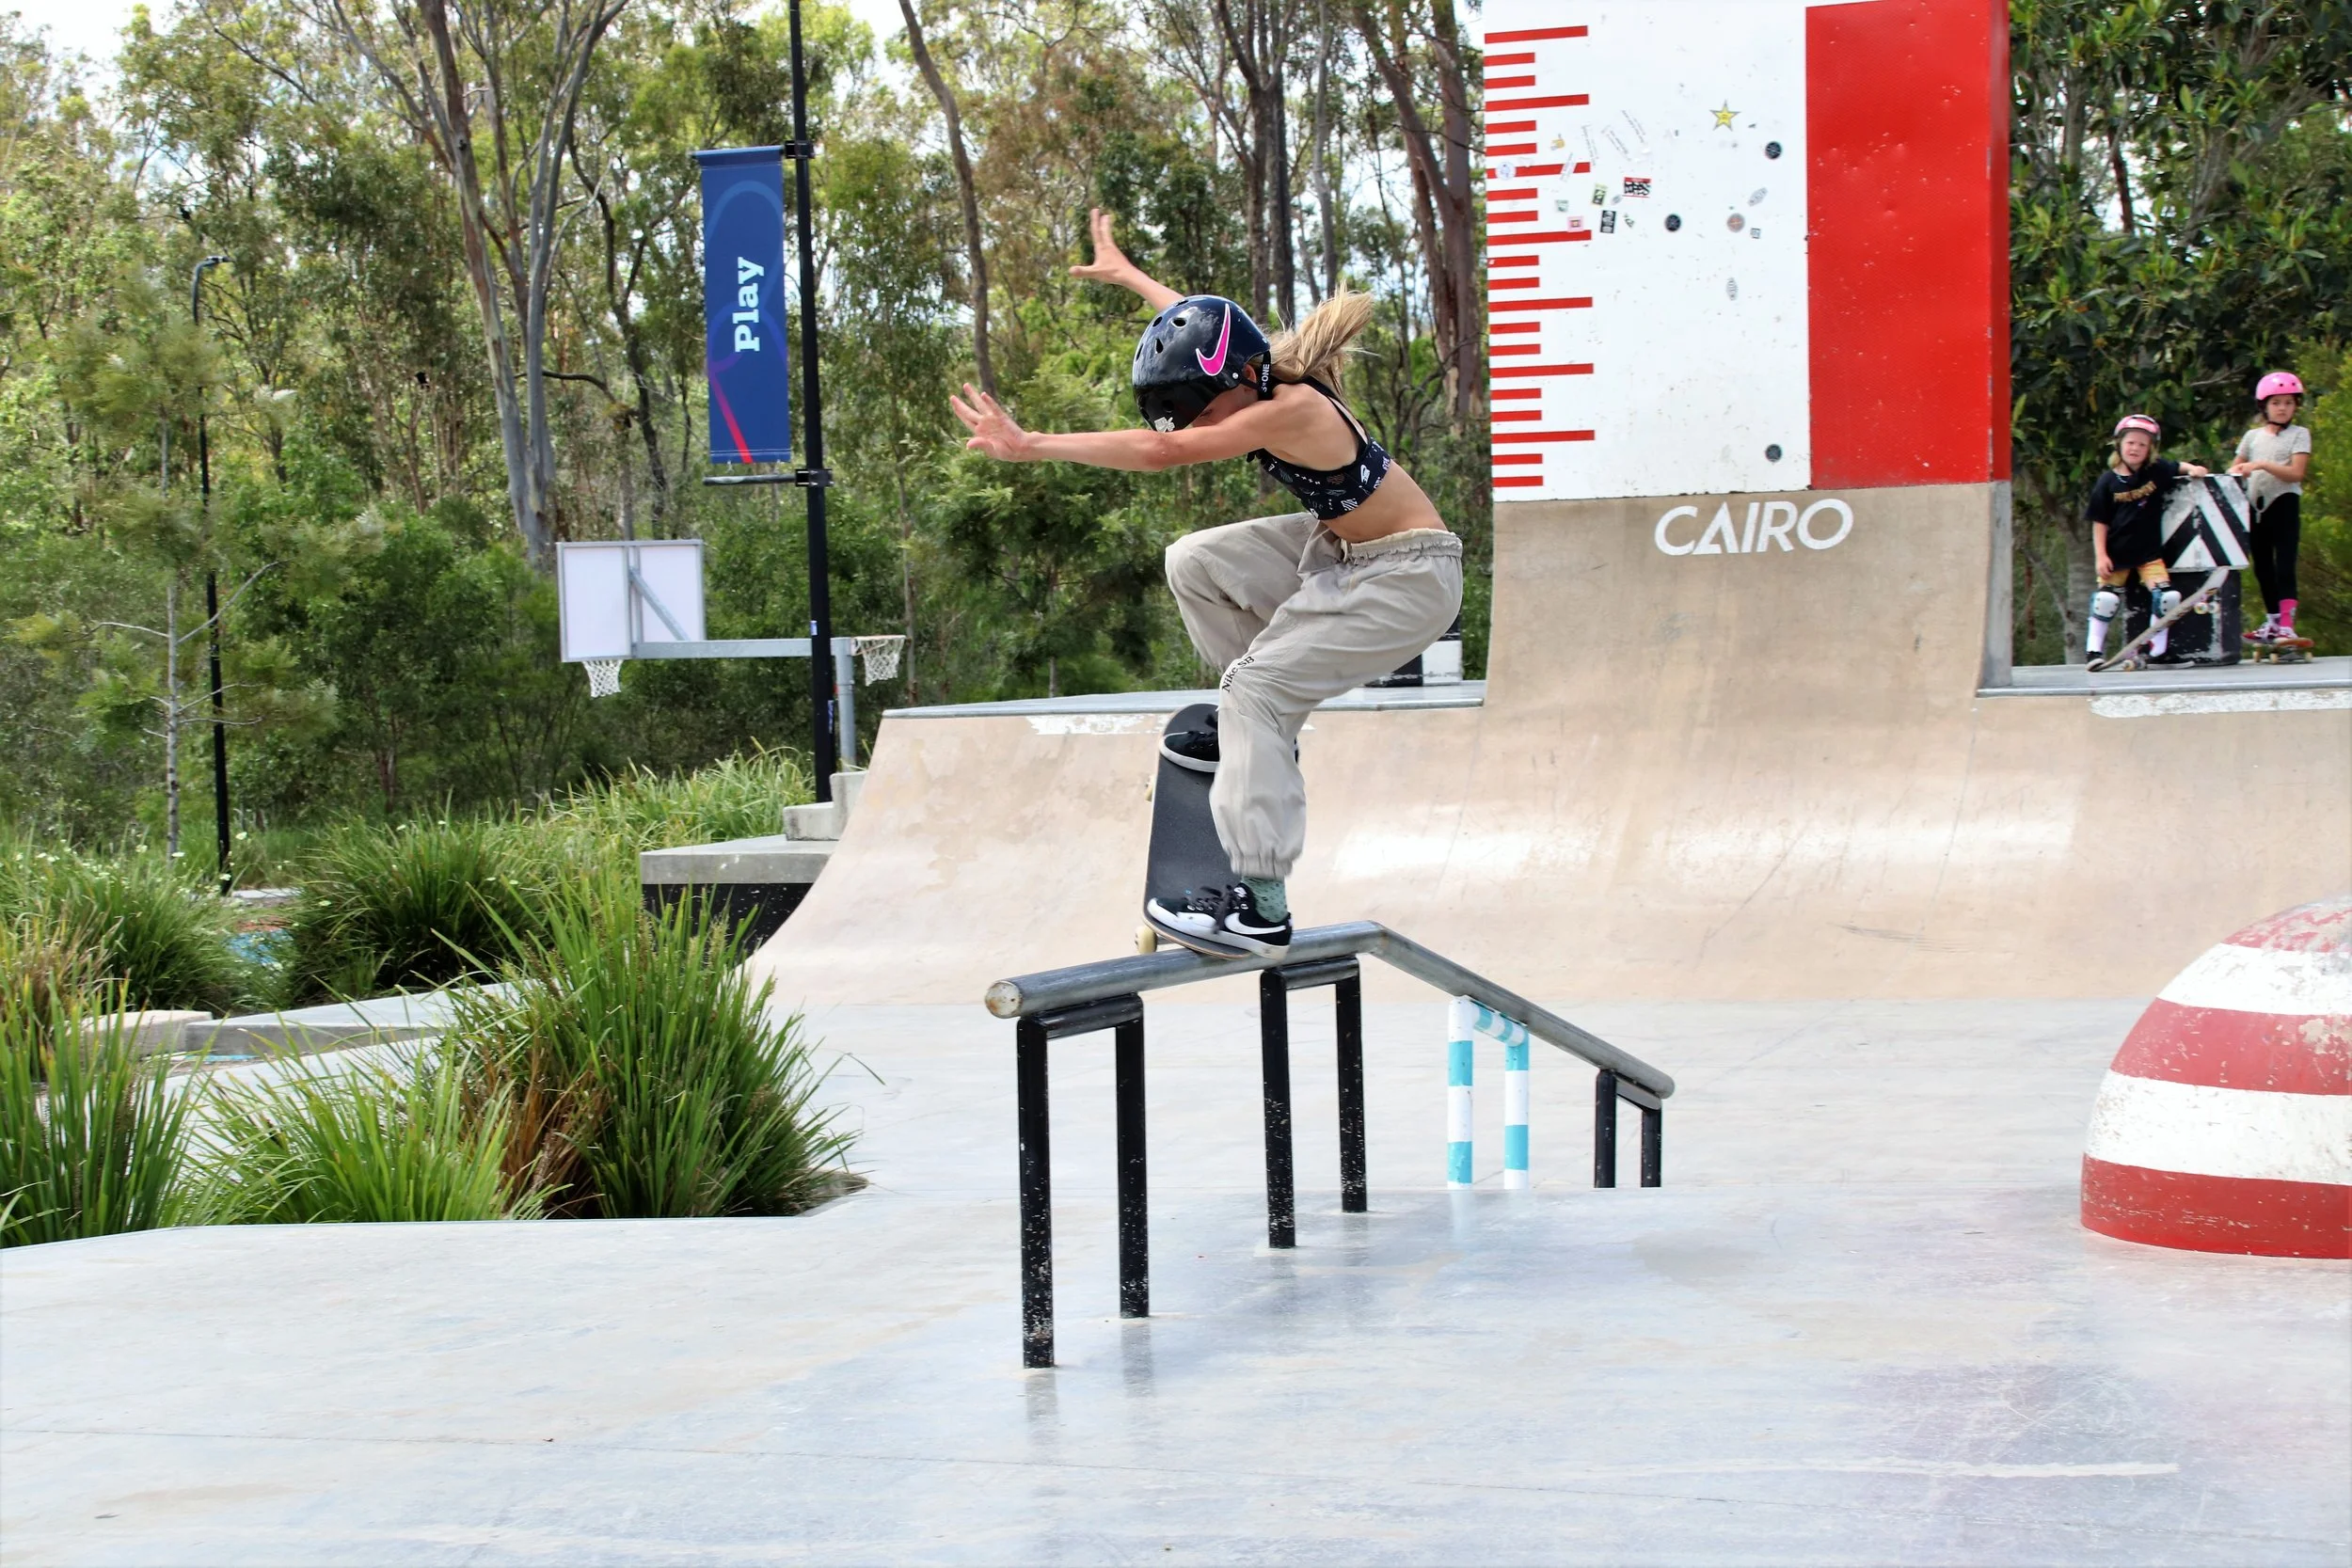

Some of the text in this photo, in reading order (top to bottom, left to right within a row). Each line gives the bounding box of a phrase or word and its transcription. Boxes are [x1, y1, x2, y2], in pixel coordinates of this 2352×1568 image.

[732, 256, 765, 353] Play
[1654, 498, 1854, 556] CAIRO
[1222, 656, 1255, 693] Nike SB
